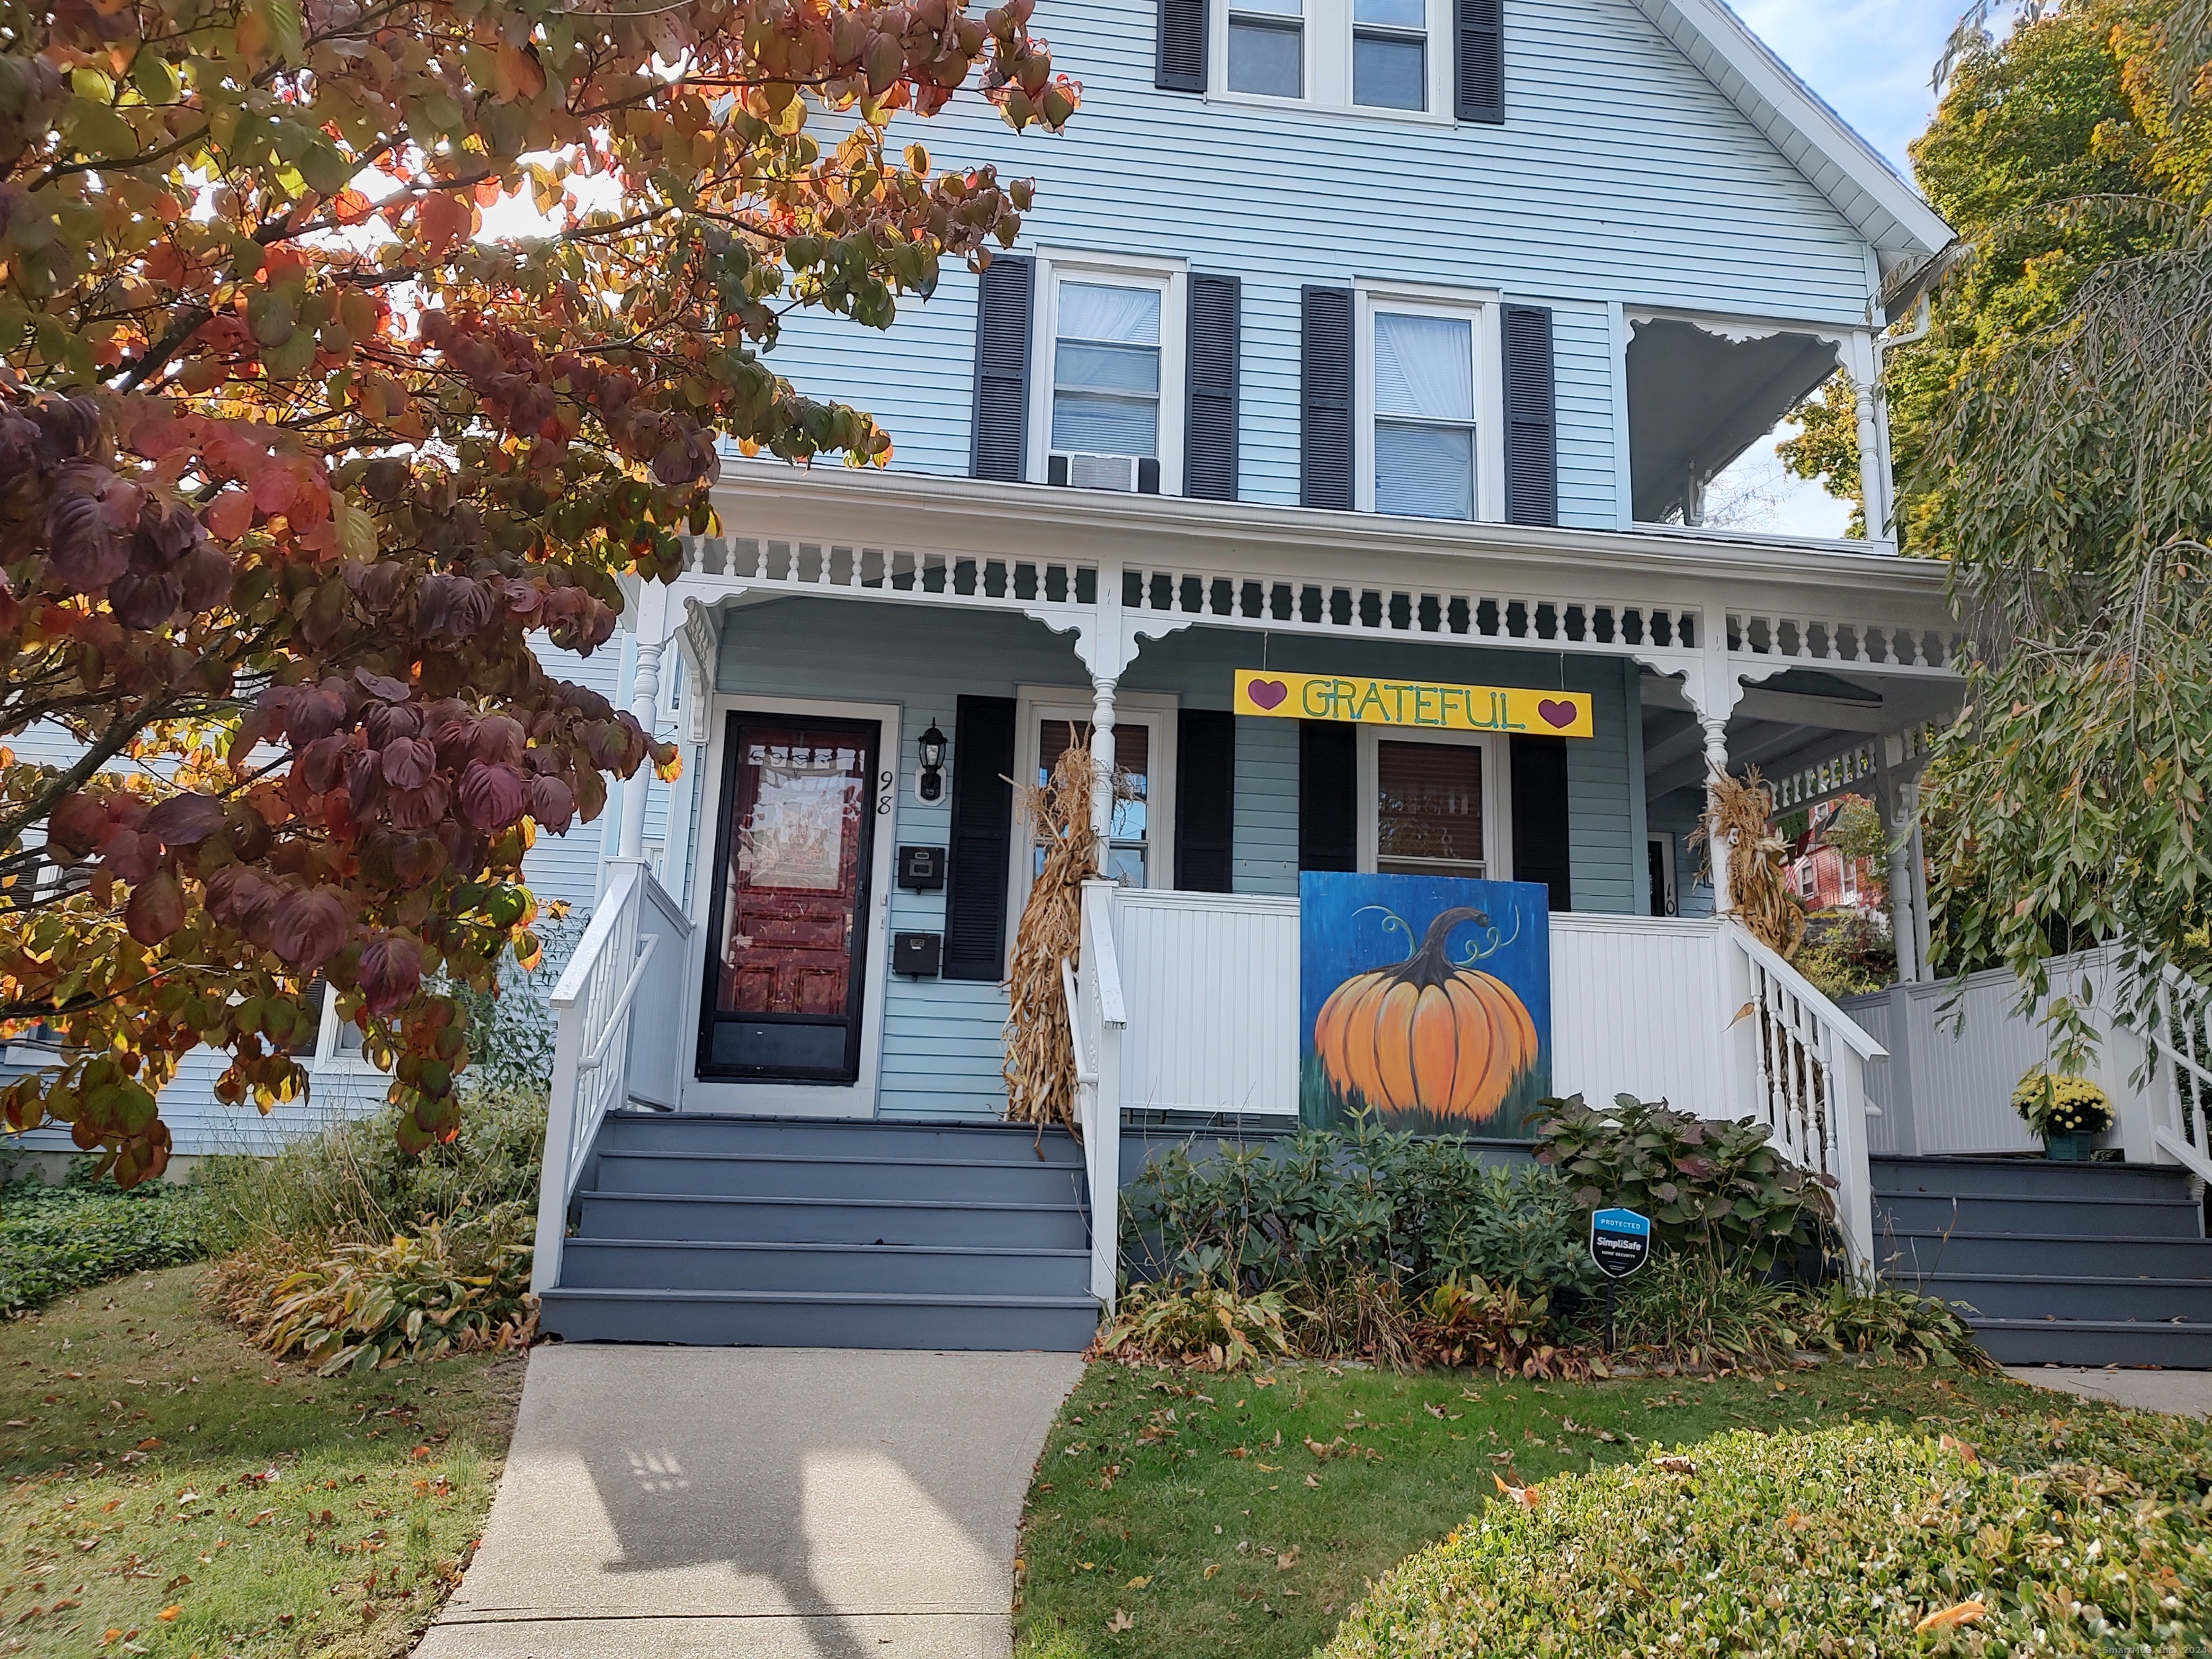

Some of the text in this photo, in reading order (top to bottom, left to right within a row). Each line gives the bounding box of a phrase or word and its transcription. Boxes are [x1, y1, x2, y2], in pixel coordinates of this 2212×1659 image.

[1301, 678, 1527, 730] GRATEFUL
[877, 770, 893, 814] 98
[1601, 1218, 1641, 1230] PROTECTED
[1596, 1236, 1642, 1251] SimpliSafe
